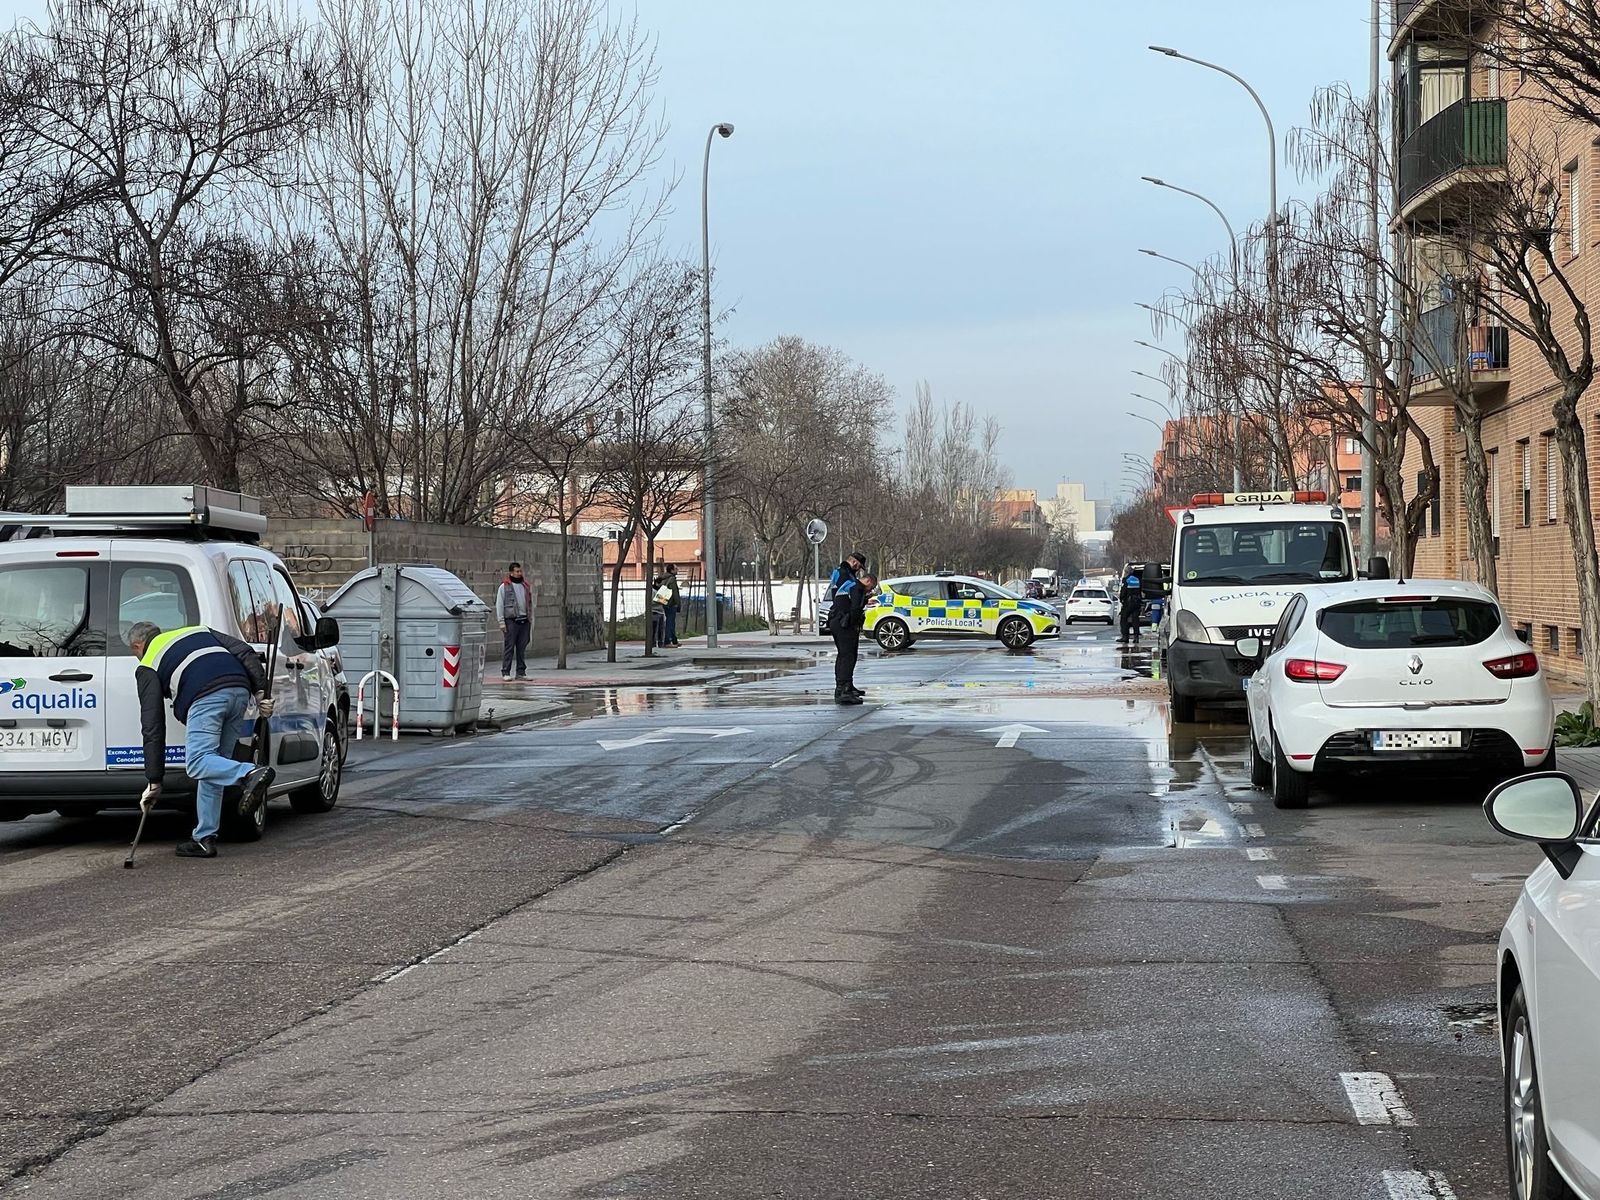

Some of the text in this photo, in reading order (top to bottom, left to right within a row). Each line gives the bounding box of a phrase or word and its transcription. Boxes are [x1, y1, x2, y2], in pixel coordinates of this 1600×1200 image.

[1234, 493, 1284, 503] GRUA
[1209, 591, 1270, 604] POLICIA
[954, 619, 975, 627] Local
[11, 687, 97, 715] aqualia
[41, 731, 73, 747] MGV
[129, 748, 144, 756] Ayun
